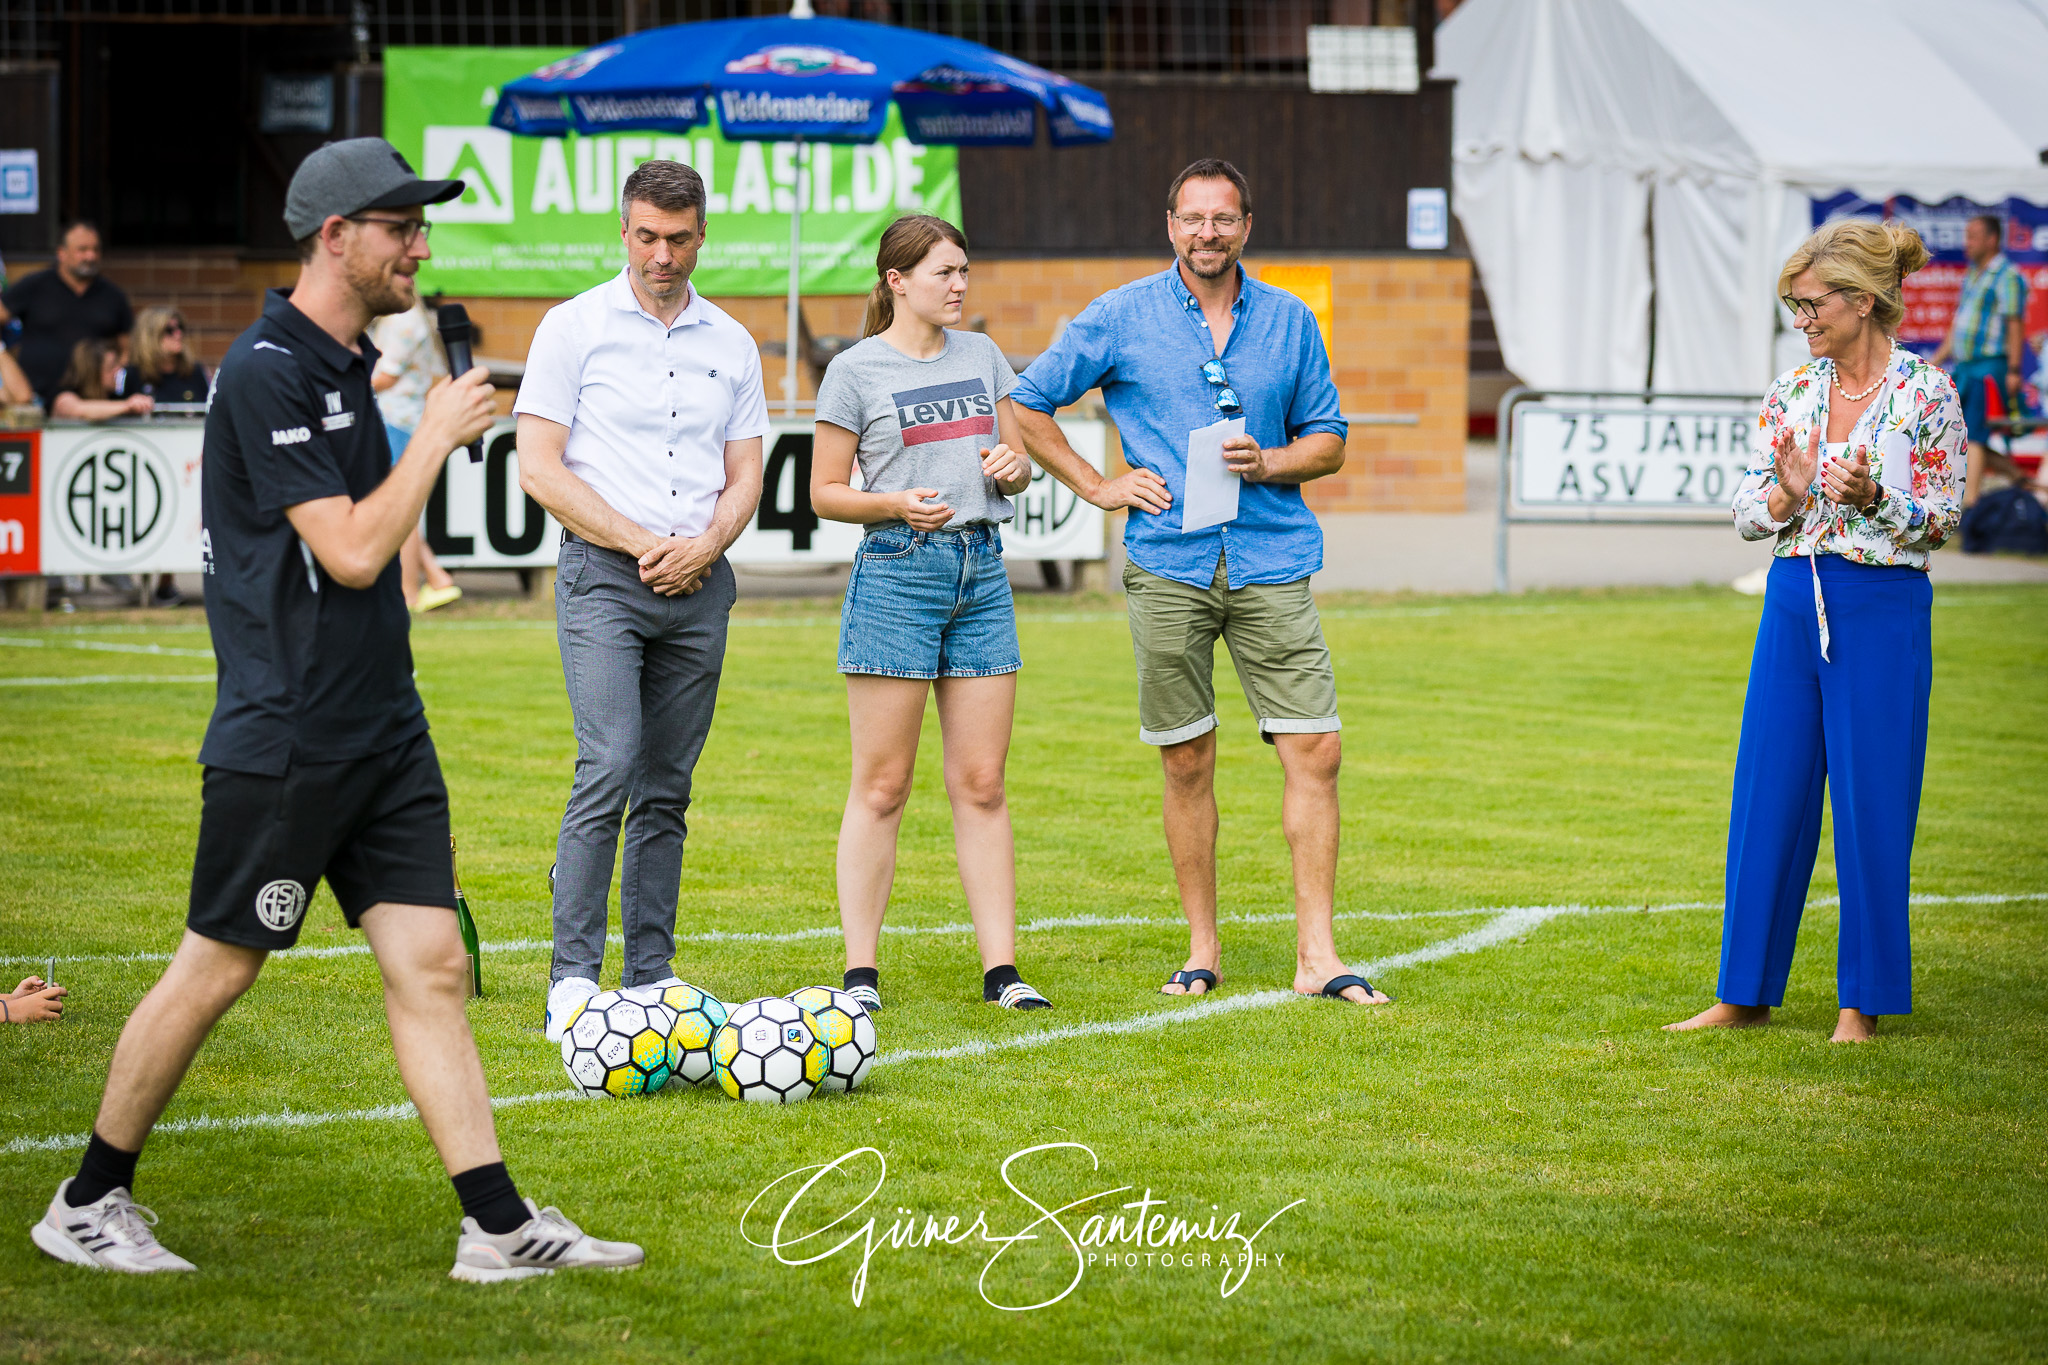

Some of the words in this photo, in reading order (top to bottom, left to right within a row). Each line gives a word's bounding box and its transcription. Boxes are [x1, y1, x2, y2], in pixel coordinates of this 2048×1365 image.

[720, 89, 873, 124] Veldensteiner
[271, 426, 311, 446] JAKO
[1561, 413, 1608, 452] 75
[1557, 463, 1645, 498] ASV
[607, 1041, 625, 1060] 2023
